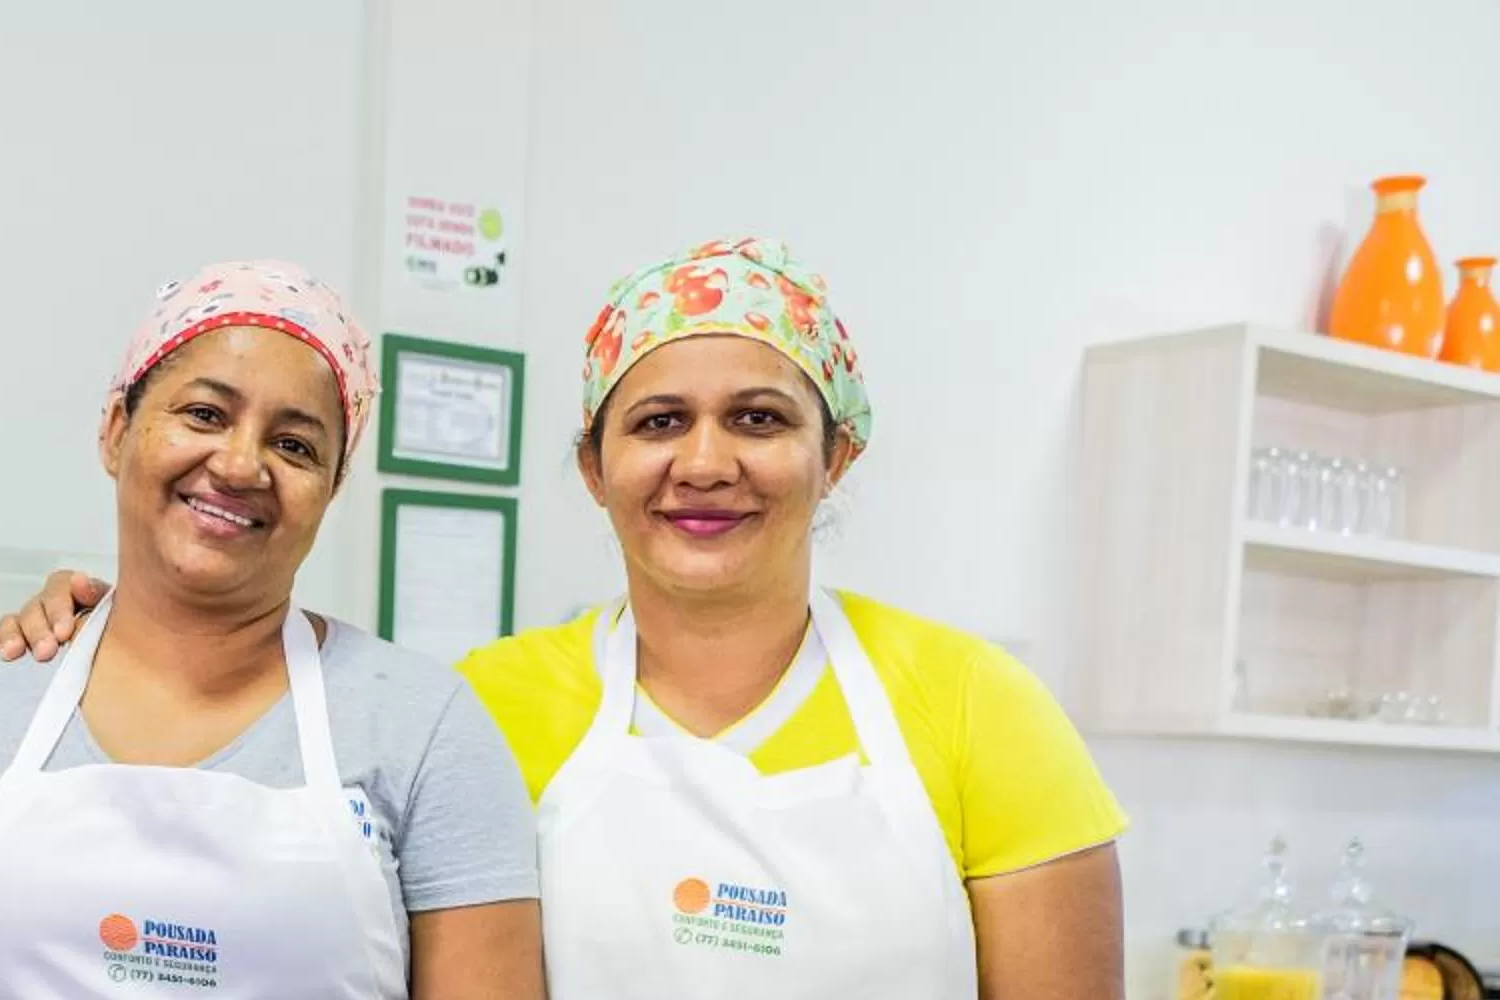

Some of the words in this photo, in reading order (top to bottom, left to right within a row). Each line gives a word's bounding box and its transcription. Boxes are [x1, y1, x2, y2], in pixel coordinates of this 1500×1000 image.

[717, 883, 787, 907] POUSADA
[144, 919, 217, 945] POUSADA
[131, 968, 154, 983] (77)
